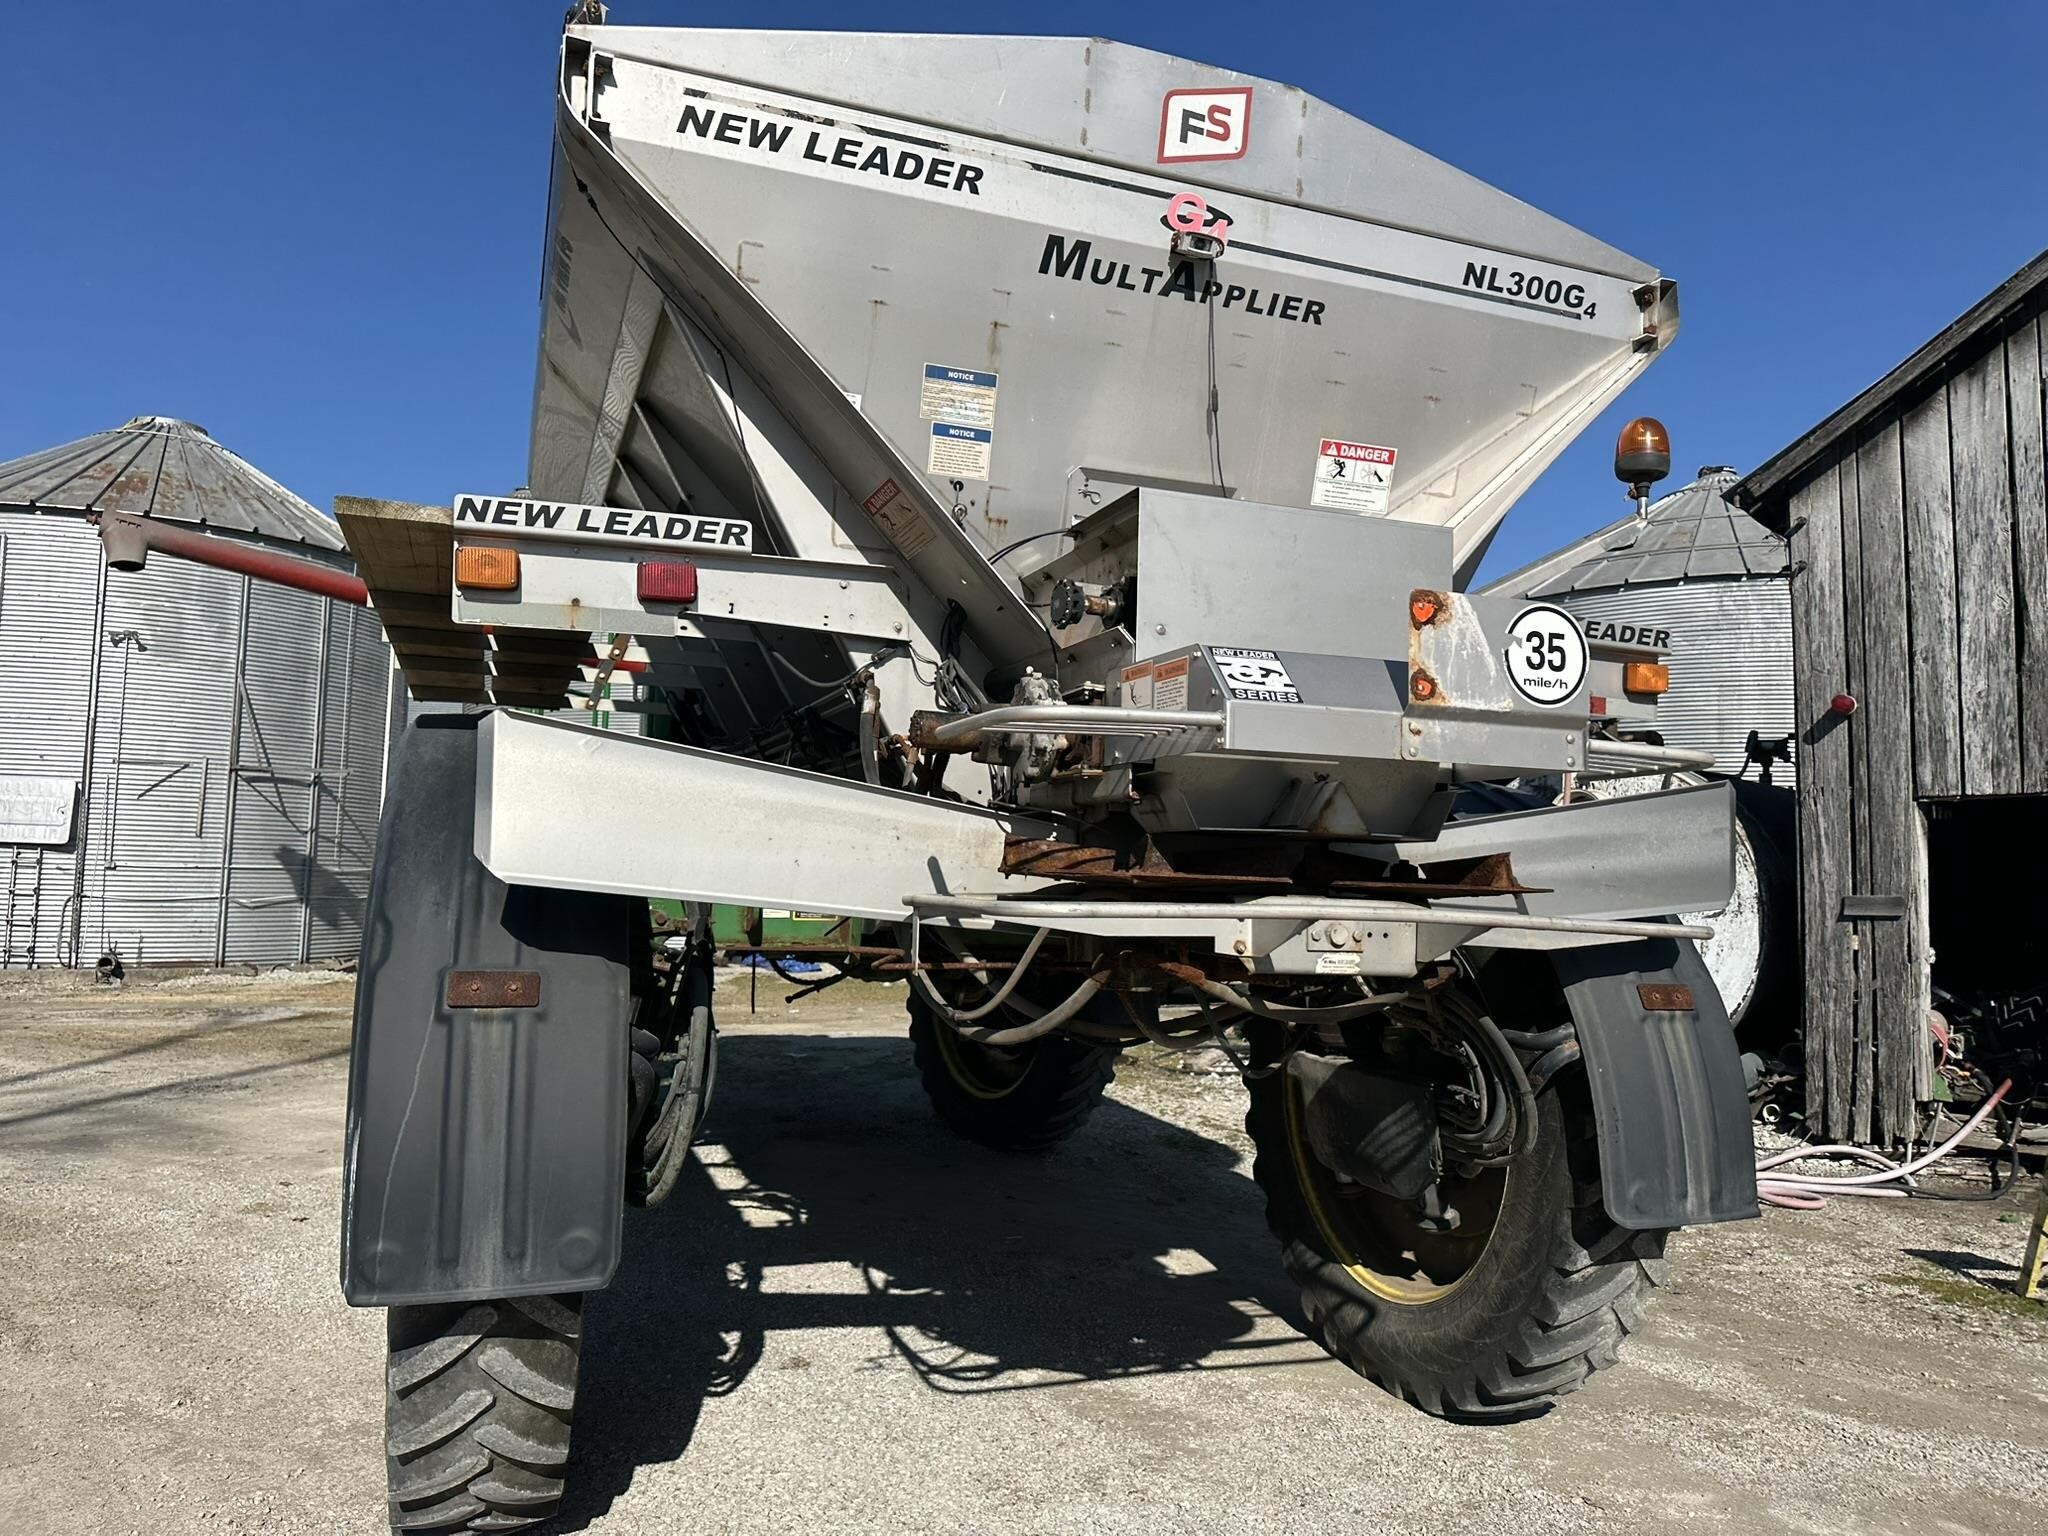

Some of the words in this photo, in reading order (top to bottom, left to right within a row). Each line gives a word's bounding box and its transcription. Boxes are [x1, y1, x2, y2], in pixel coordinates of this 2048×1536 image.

[1179, 104, 1231, 144] FS
[676, 104, 793, 152] NEW
[802, 131, 984, 196] LEADER
[1462, 262, 1597, 319] NL300G4
[947, 370, 975, 381] NOTICE
[948, 428, 975, 438] NOTICE
[1339, 444, 1390, 463] DANGER
[871, 483, 899, 509] DANGER
[455, 497, 566, 528] NEW
[576, 509, 749, 546] LEADER
[1584, 620, 1670, 648] EADER
[1212, 647, 1234, 657] NEW
[1236, 649, 1275, 659] LEADER
[1526, 630, 1567, 673] 35
[1234, 689, 1299, 702] SERIES
[1523, 677, 1568, 690] mile/h
